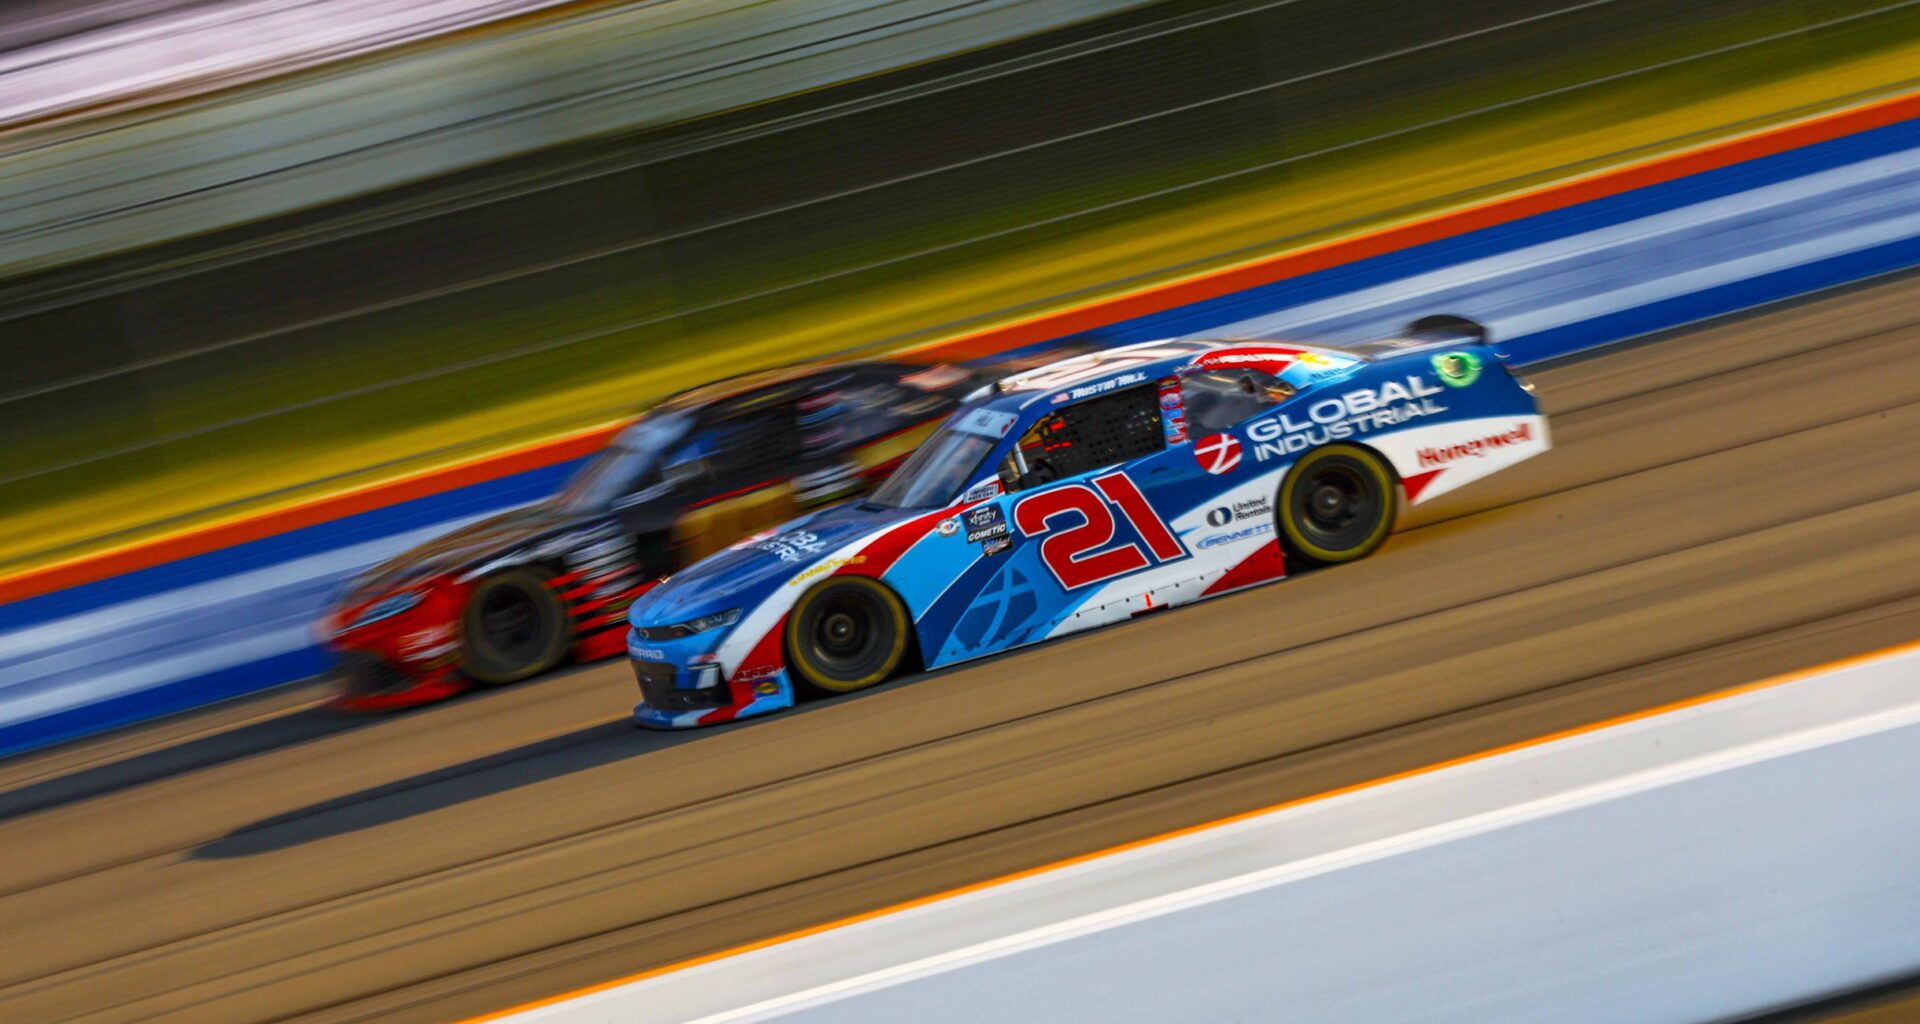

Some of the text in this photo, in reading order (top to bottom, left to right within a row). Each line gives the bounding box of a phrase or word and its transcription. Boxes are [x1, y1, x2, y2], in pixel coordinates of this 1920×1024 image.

[1246, 375, 1445, 442] GLOBAL
[1253, 399, 1449, 462] INDUSTRIAL
[1415, 423, 1533, 468] Honeywell
[1232, 495, 1267, 513] United
[1235, 505, 1273, 521] Rentals
[968, 523, 1006, 542] COMETIC
[1014, 471, 1187, 592] 21
